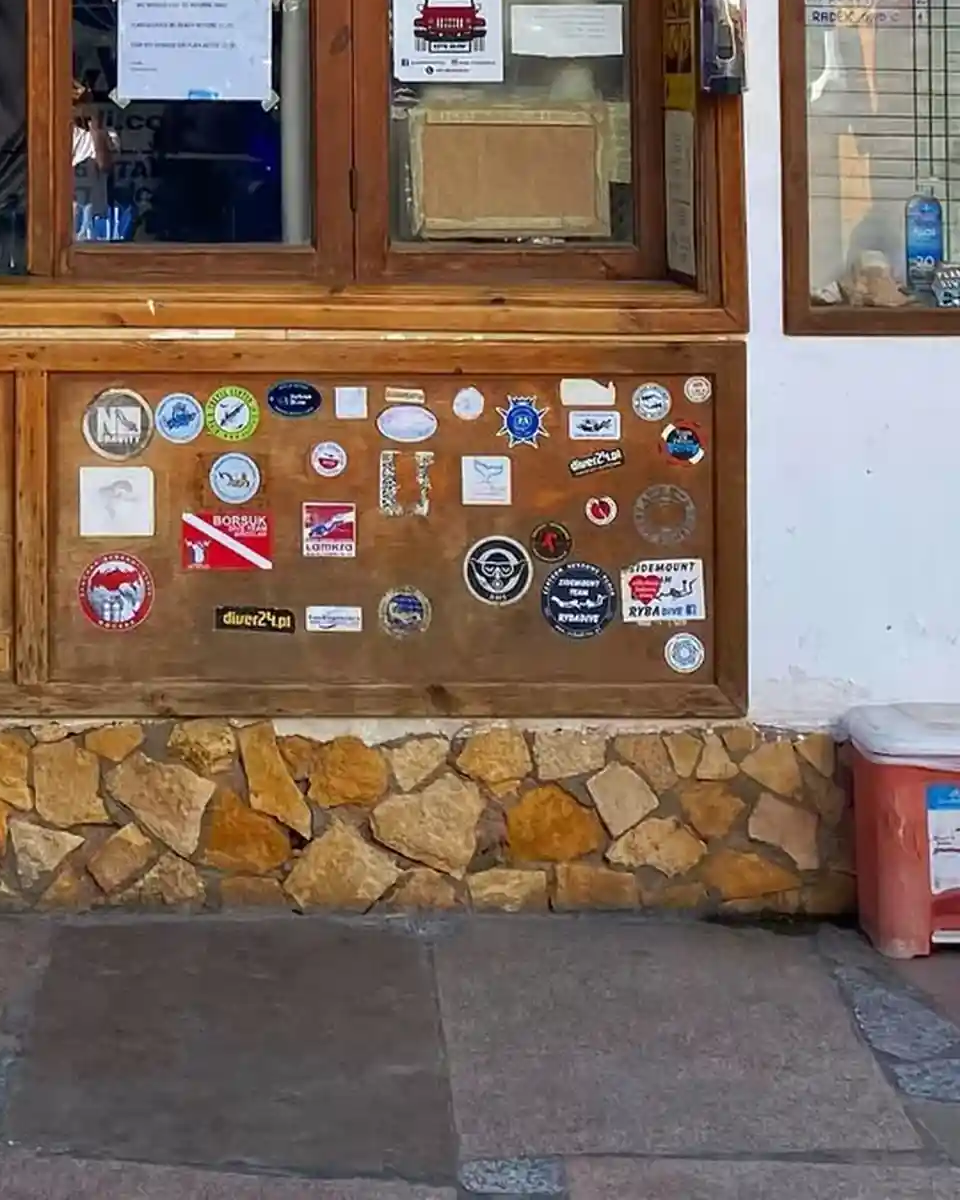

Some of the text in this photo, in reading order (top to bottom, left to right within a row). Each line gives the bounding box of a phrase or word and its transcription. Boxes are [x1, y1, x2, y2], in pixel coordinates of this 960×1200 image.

[213, 515, 267, 526] BORSUK
[630, 562, 696, 573] SIDEMOUNT
[558, 579, 601, 588] SIDEMOUNT
[569, 589, 589, 597] TEAM
[223, 612, 291, 630] diver24.pl
